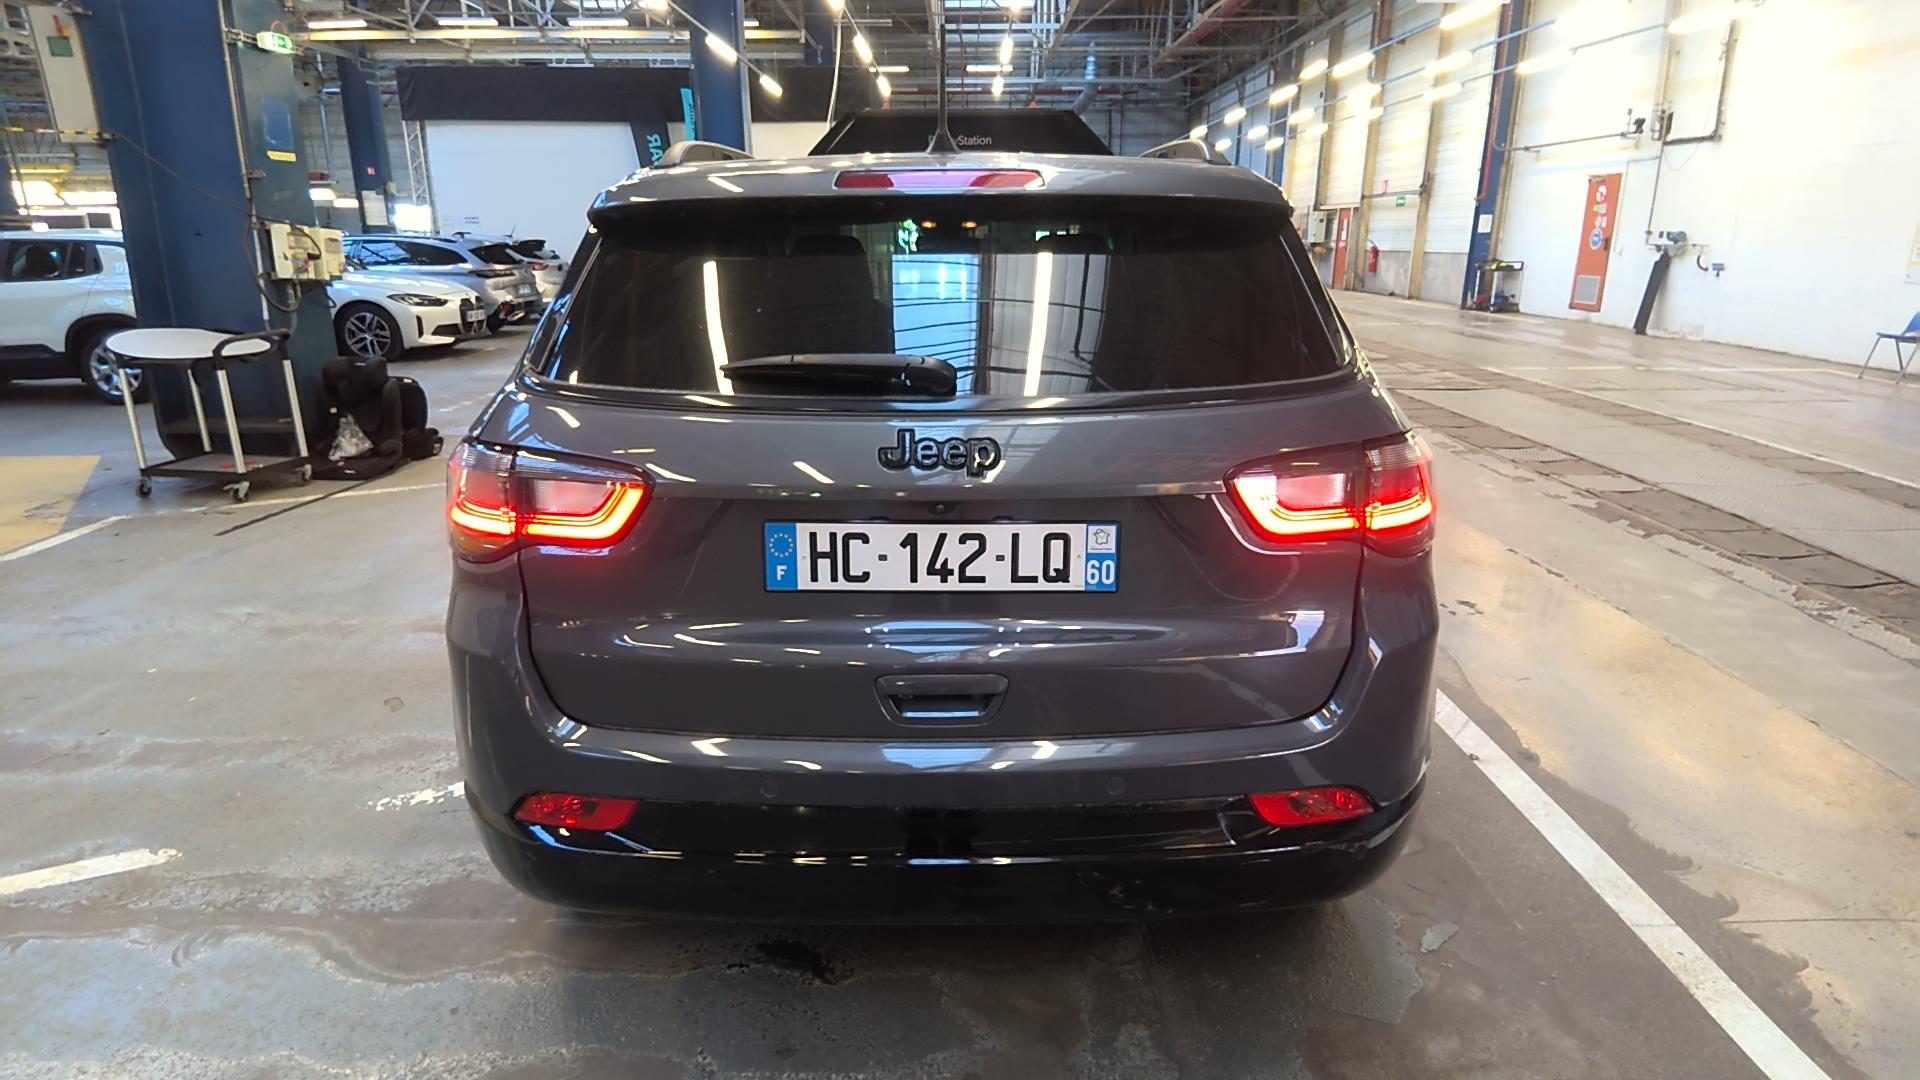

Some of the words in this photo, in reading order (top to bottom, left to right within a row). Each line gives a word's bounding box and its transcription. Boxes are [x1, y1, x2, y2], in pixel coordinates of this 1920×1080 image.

[928, 134, 992, 146] PyStation
[878, 429, 1001, 477] Jeep
[809, 531, 1071, 584] HC-142-LQ
[776, 565, 787, 580] F
[1086, 559, 1115, 585] 60
